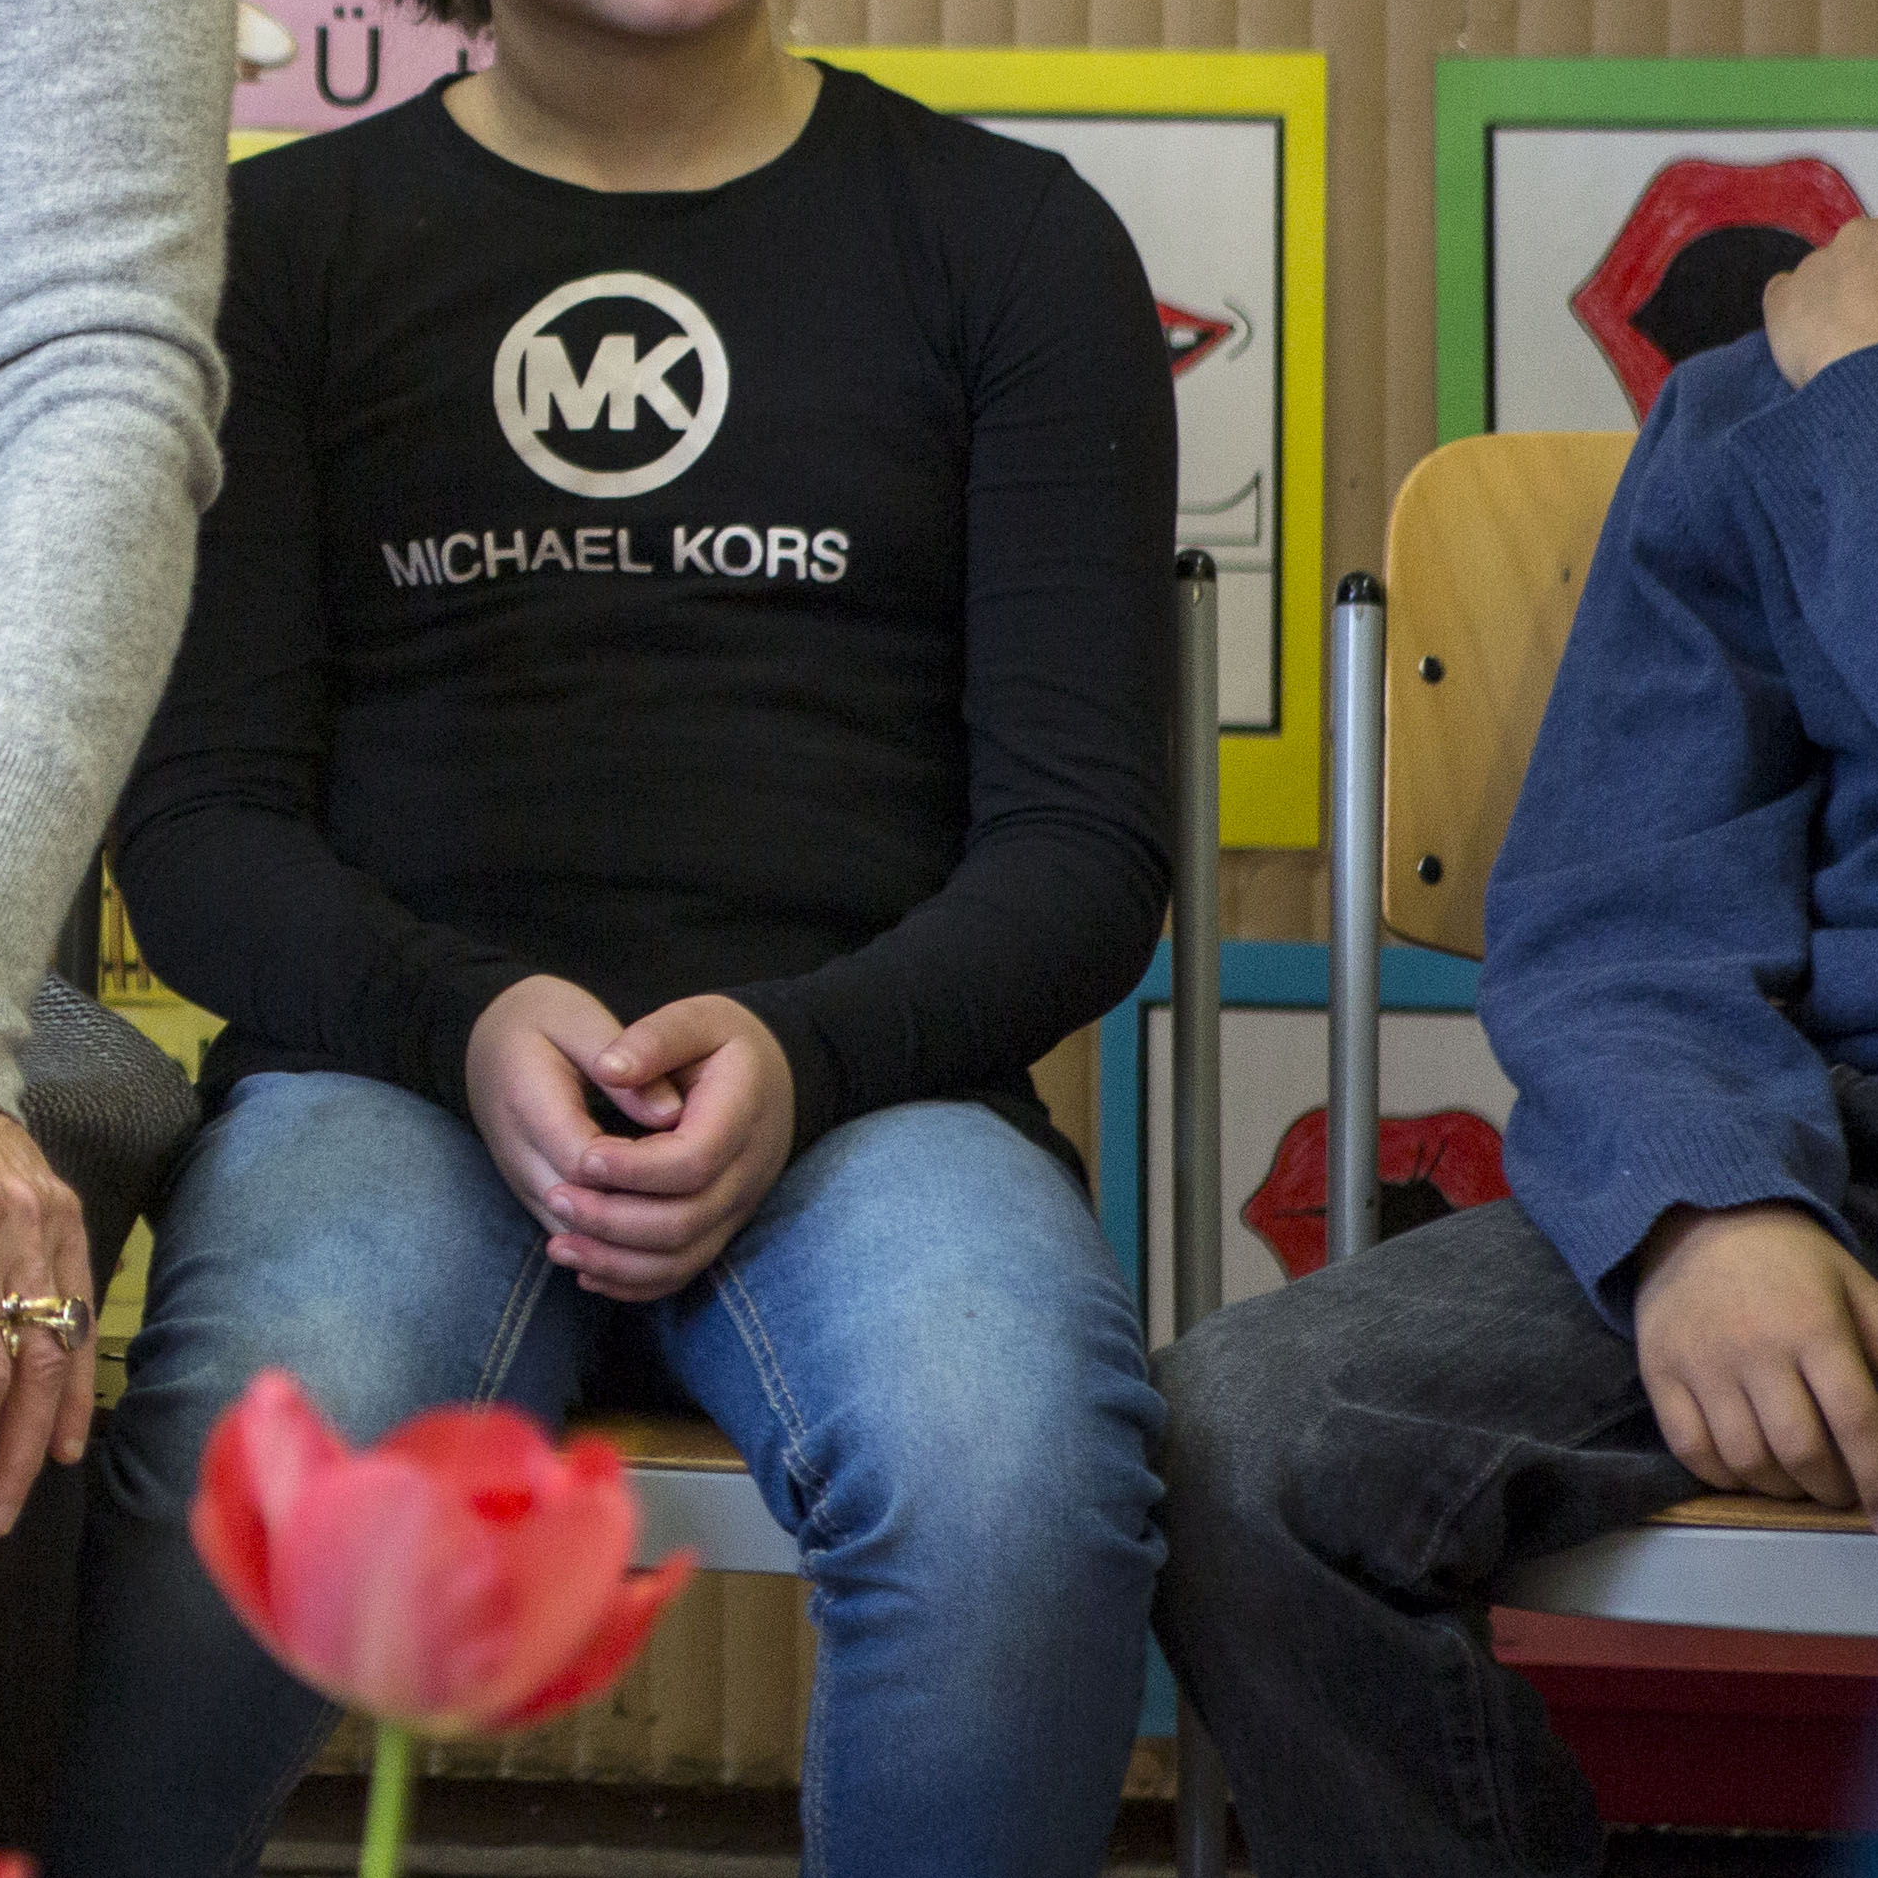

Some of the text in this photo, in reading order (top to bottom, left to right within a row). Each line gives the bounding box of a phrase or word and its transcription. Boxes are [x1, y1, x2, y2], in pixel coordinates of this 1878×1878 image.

[314, 5, 382, 109] Ü
[525, 333, 697, 431] MK
[381, 523, 851, 588] MICHAEL KORS
